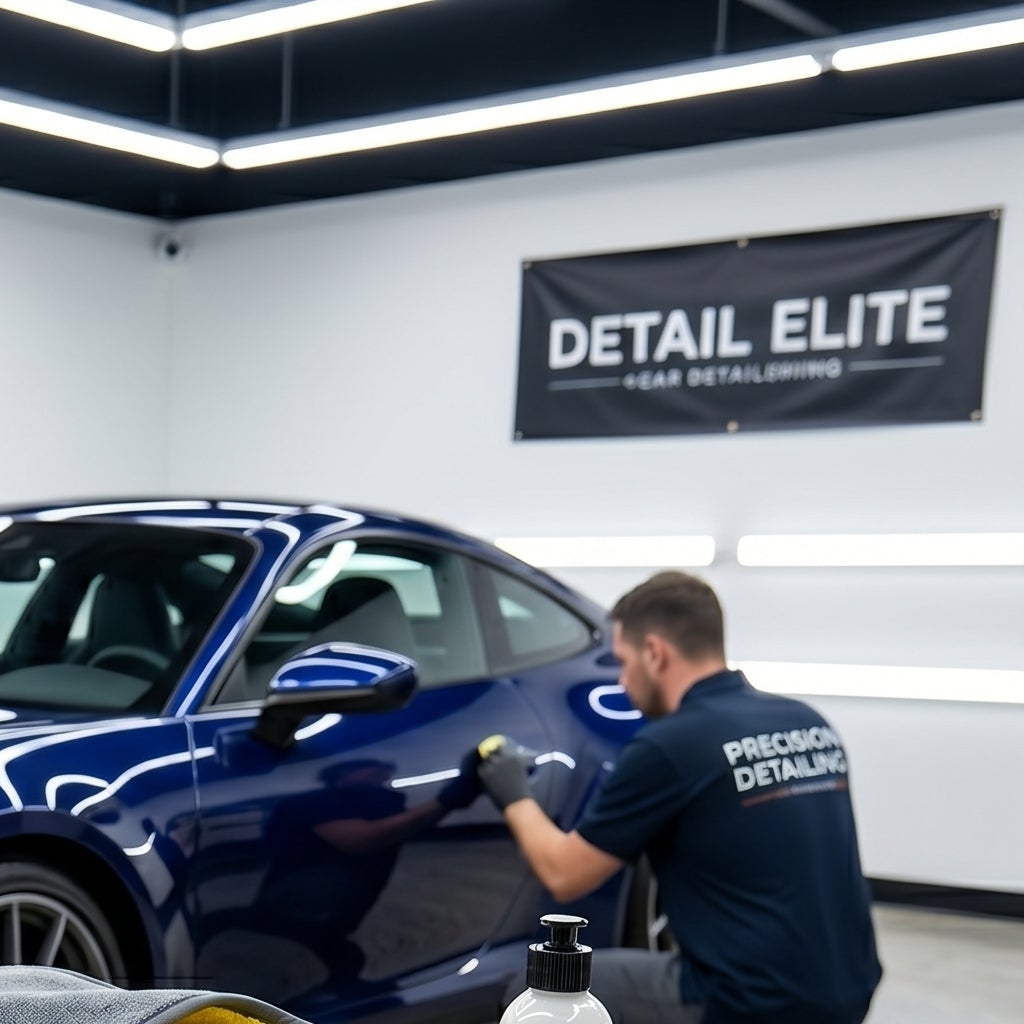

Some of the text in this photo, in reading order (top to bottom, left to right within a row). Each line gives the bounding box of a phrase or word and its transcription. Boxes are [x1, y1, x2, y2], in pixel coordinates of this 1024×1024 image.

[548, 284, 952, 370] DETAIL ELITE
[722, 726, 841, 766] PRECISION
[733, 749, 848, 792] DETAILING
